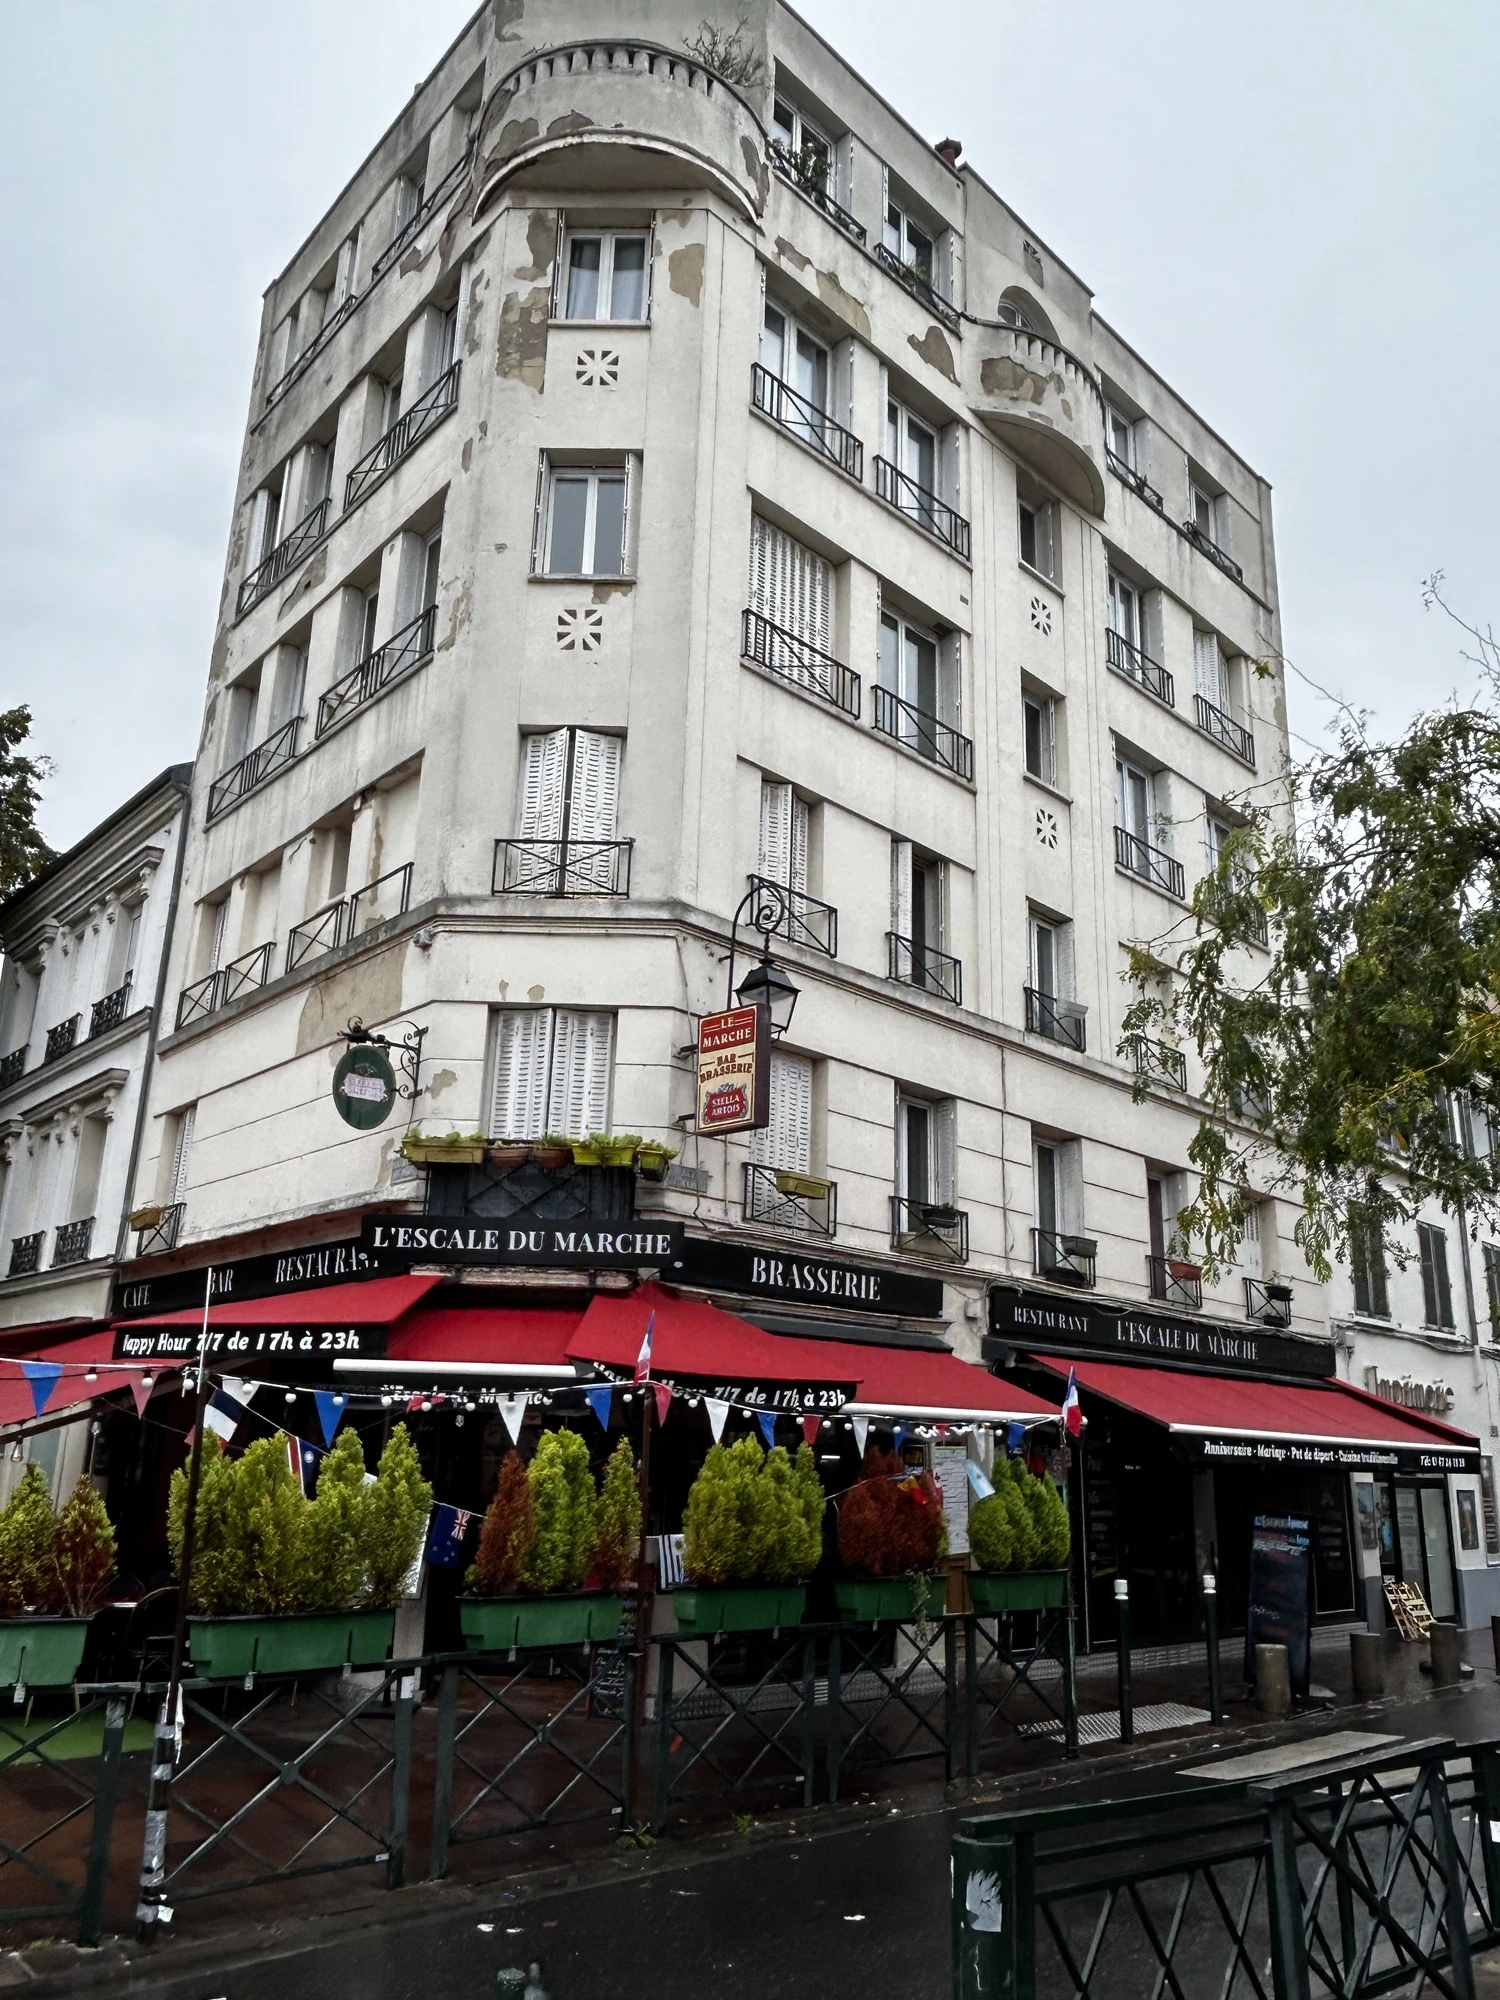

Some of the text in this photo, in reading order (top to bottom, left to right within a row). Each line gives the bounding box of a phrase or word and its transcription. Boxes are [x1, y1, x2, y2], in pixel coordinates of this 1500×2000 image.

[720, 1016, 735, 1029] LE
[702, 1027, 752, 1048] MARCHE
[716, 1053, 737, 1067] BAR
[699, 1062, 753, 1084] BRASSERIE
[711, 1094, 740, 1107] STELLA
[711, 1103, 740, 1117] ARTOIS
[373, 1226, 671, 1255] L'ESCALE DU MARCHE
[275, 1246, 379, 1284] RESTAURA
[751, 1257, 880, 1301] BRASSERIE
[1013, 1306, 1089, 1333] RESTAURANT
[157, 1332, 192, 1351] Hour
[196, 1332, 224, 1352] 7/7
[227, 1330, 250, 1350] de
[256, 1330, 294, 1351] 17h
[299, 1330, 314, 1350] à
[318, 1329, 360, 1350] 23h
[1117, 1320, 1259, 1361] L'ESCALE DU MARCHE
[714, 1386, 742, 1404] 7/7
[744, 1386, 767, 1405] de
[772, 1388, 800, 1408] 17h
[803, 1388, 815, 1407] à
[819, 1389, 847, 1407] 23h
[1204, 1441, 1252, 1456] Anniversaire
[1257, 1444, 1287, 1461] Mariage
[1291, 1446, 1303, 1460] Pot
[1304, 1447, 1313, 1460] de
[1313, 1448, 1334, 1463] départ
